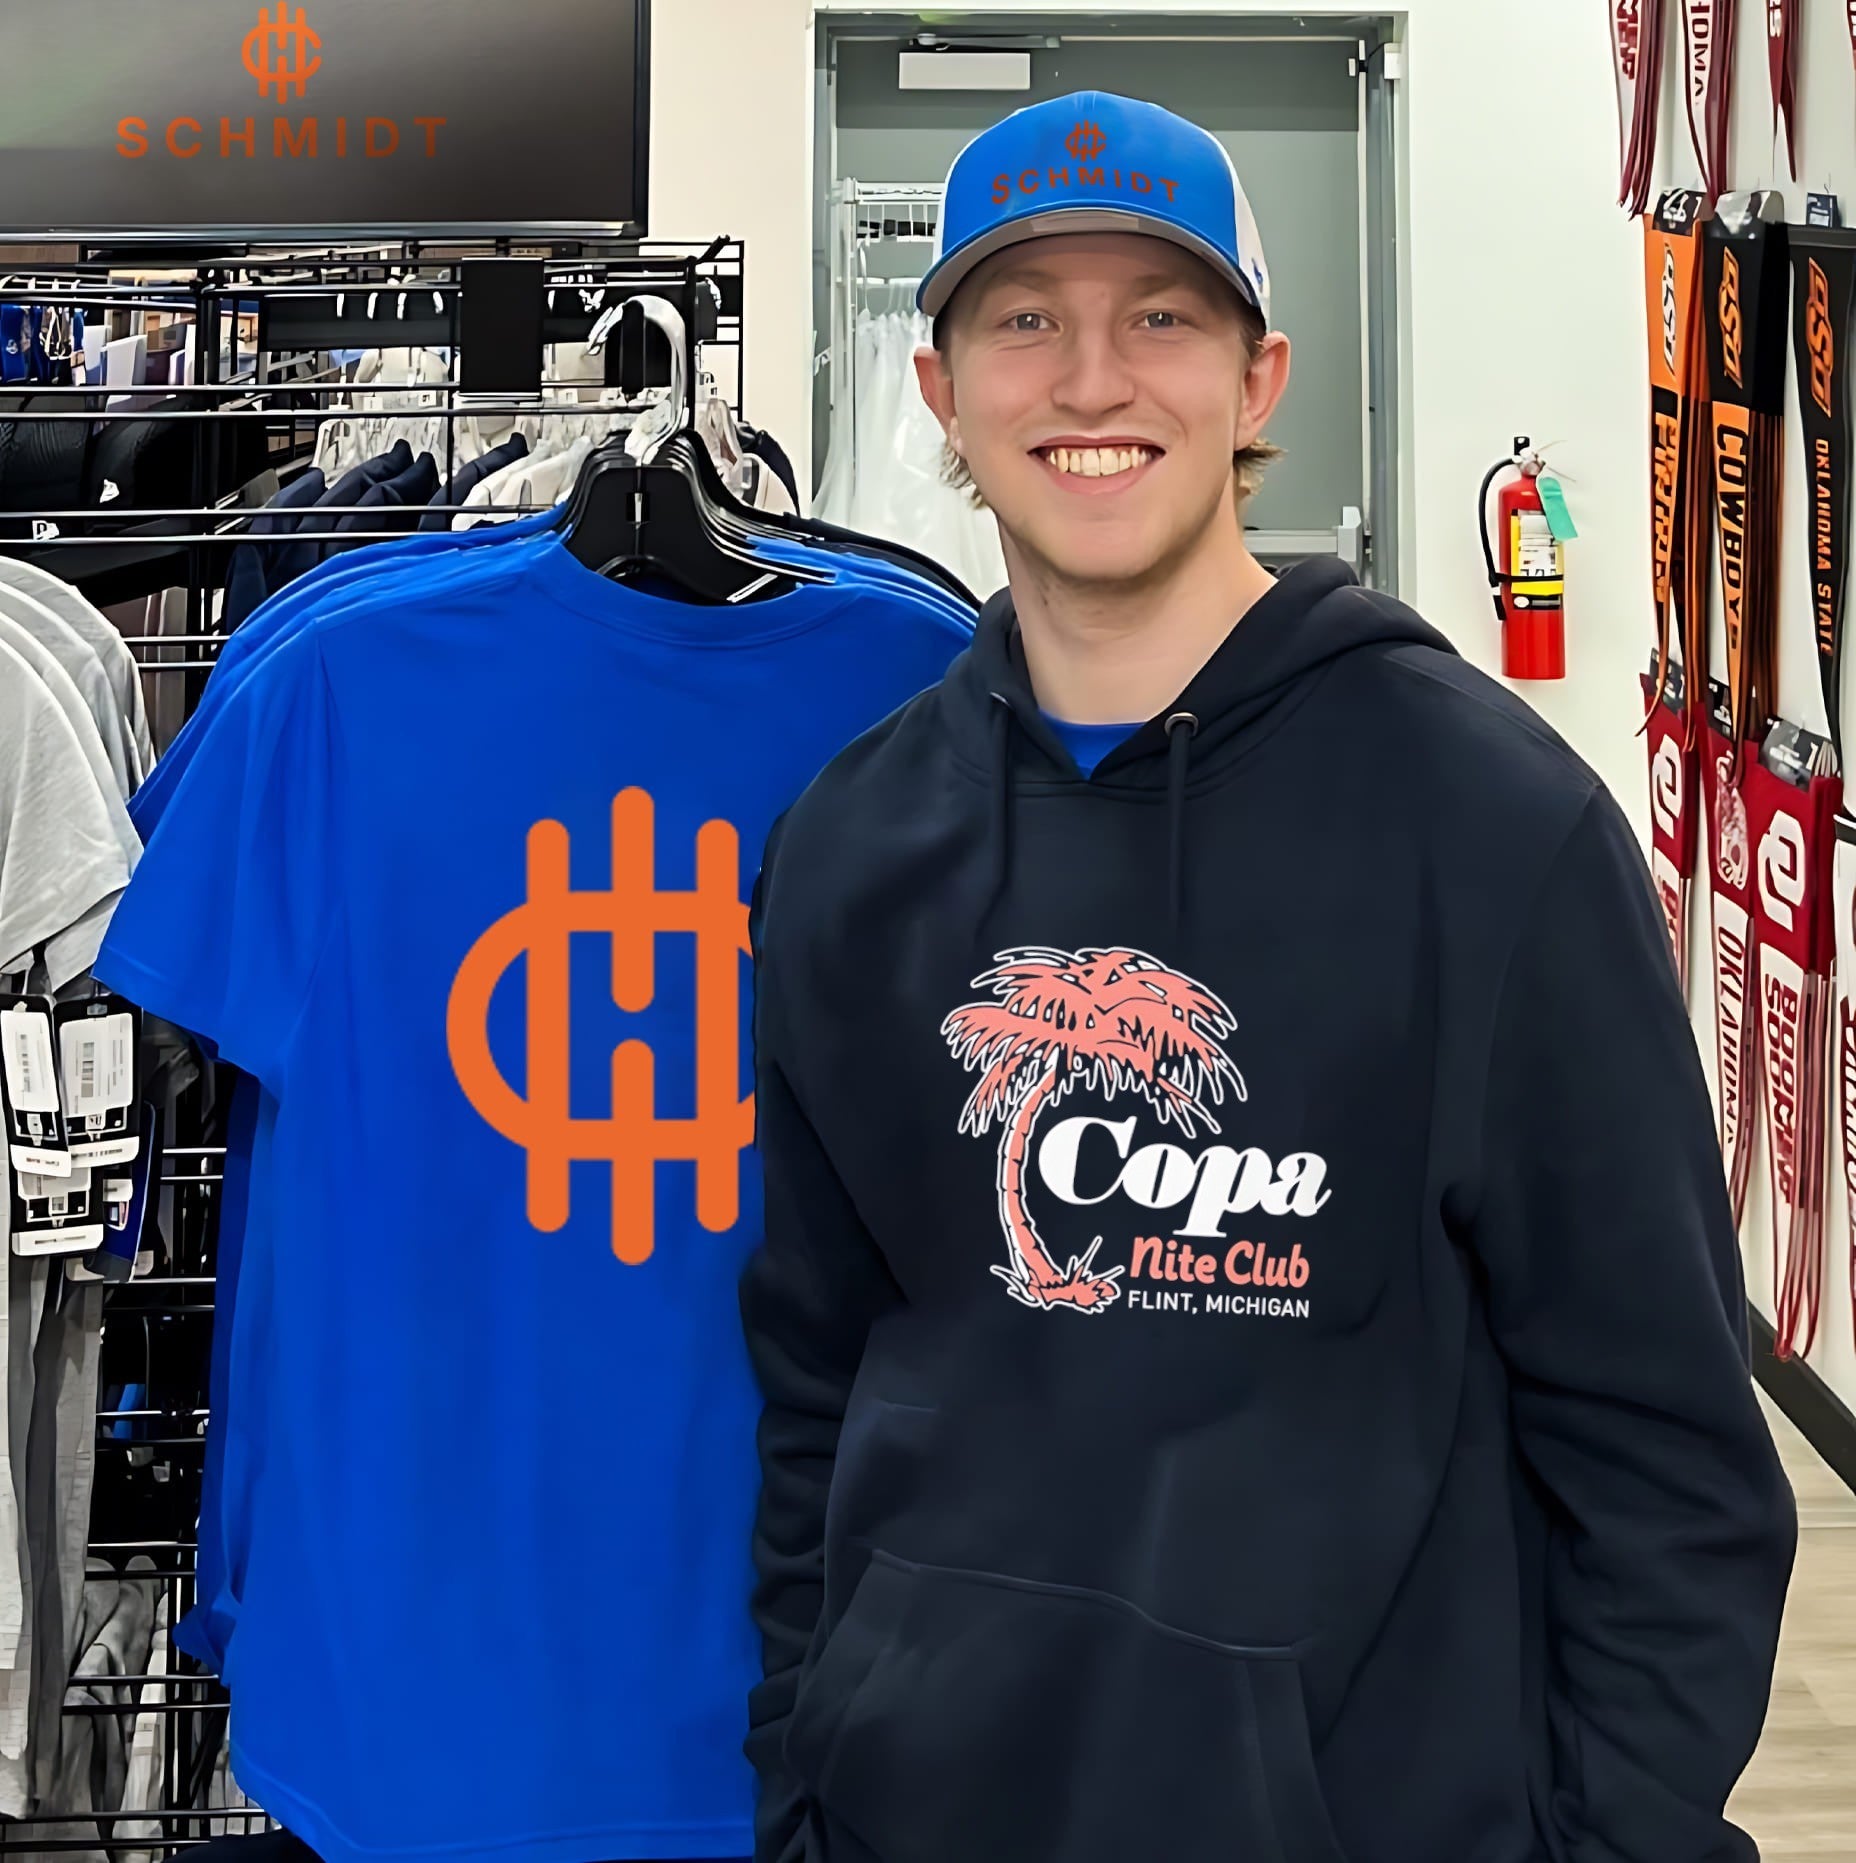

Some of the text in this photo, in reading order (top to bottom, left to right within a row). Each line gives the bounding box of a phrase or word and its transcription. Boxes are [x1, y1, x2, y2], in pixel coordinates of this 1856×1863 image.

[115, 116, 448, 158] SCHMIDT
[991, 167, 1179, 204] SCHMIDT
[1815, 438, 1832, 570] OKLAHOMA
[1038, 1116, 1332, 1238] Copa
[1129, 1236, 1310, 1288] Nite Club
[1128, 1290, 1310, 1318] FLINT, MICHIGAN
